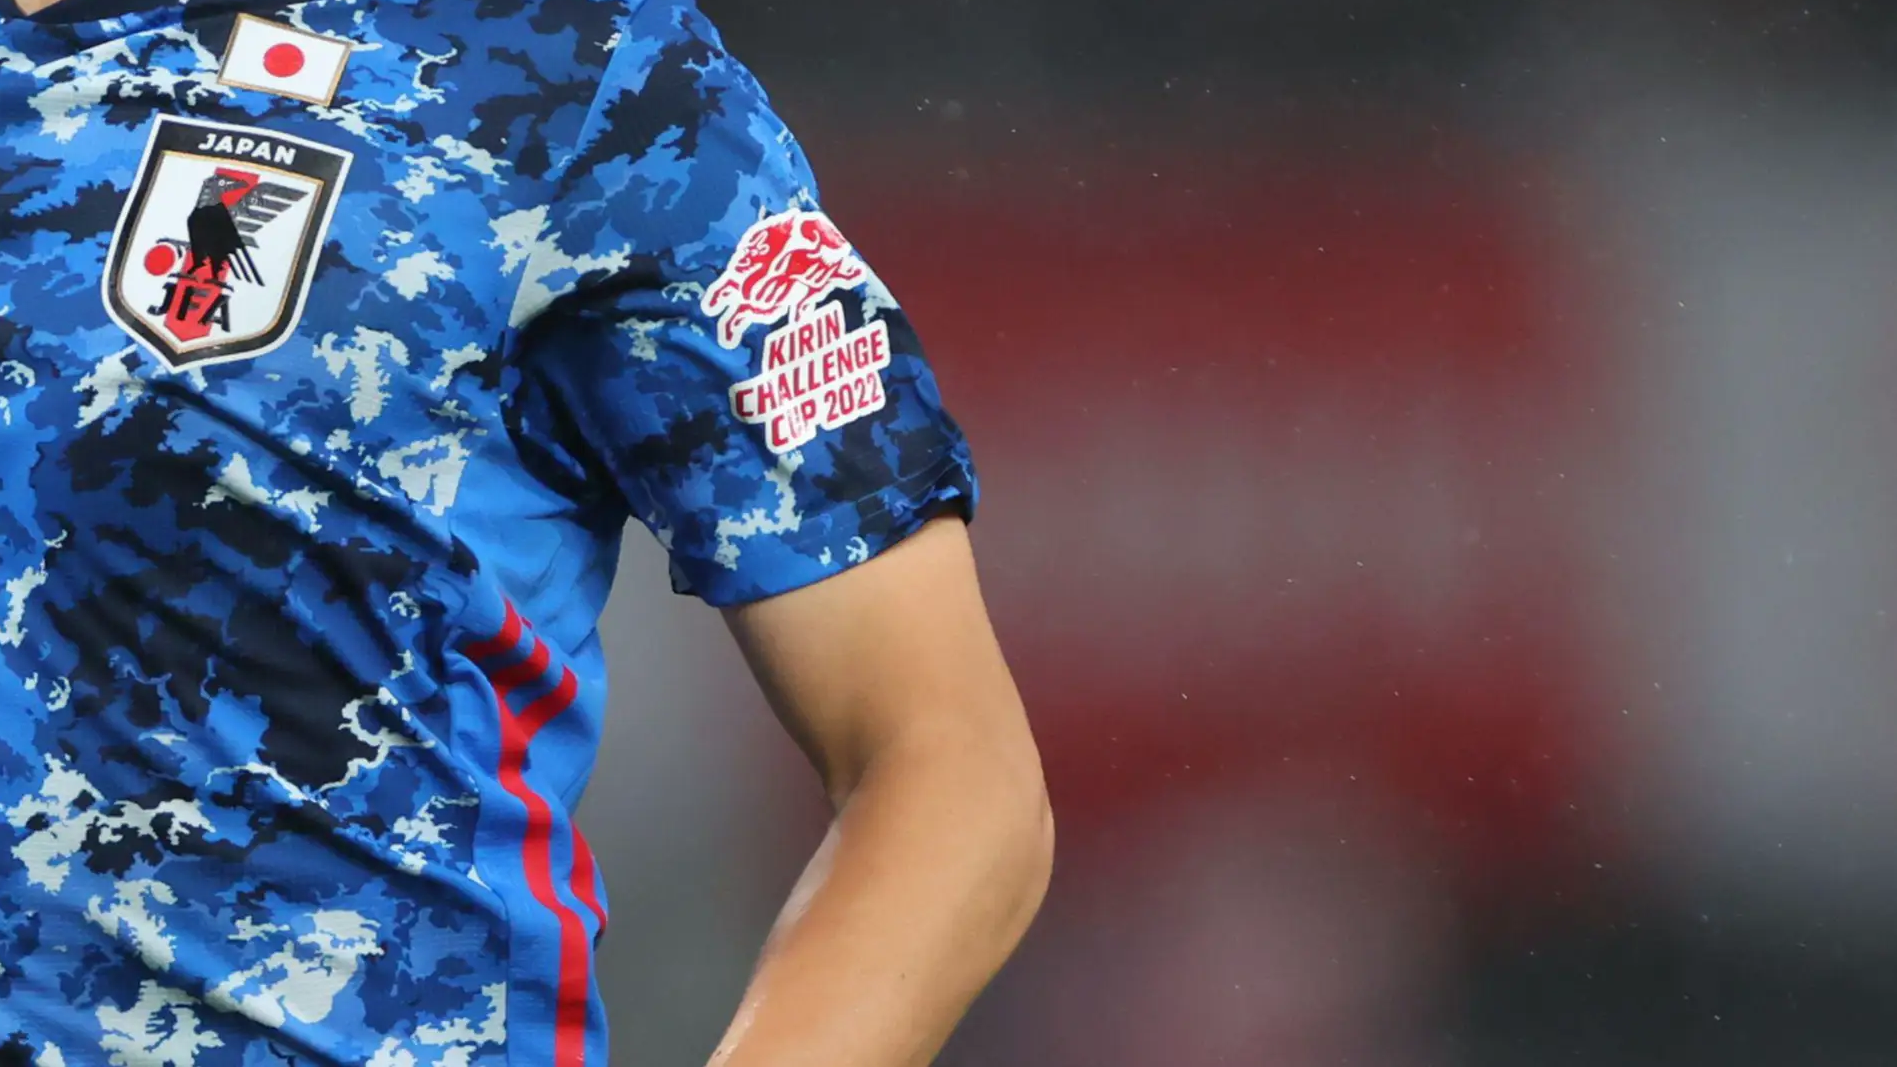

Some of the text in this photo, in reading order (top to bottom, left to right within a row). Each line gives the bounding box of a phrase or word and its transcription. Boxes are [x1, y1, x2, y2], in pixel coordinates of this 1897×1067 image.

[198, 133, 297, 166] JAPAN
[147, 282, 231, 333] JFA
[768, 309, 841, 370] KIRIN
[736, 329, 885, 418] CHALLENGE
[771, 374, 882, 447] CUP 2022
